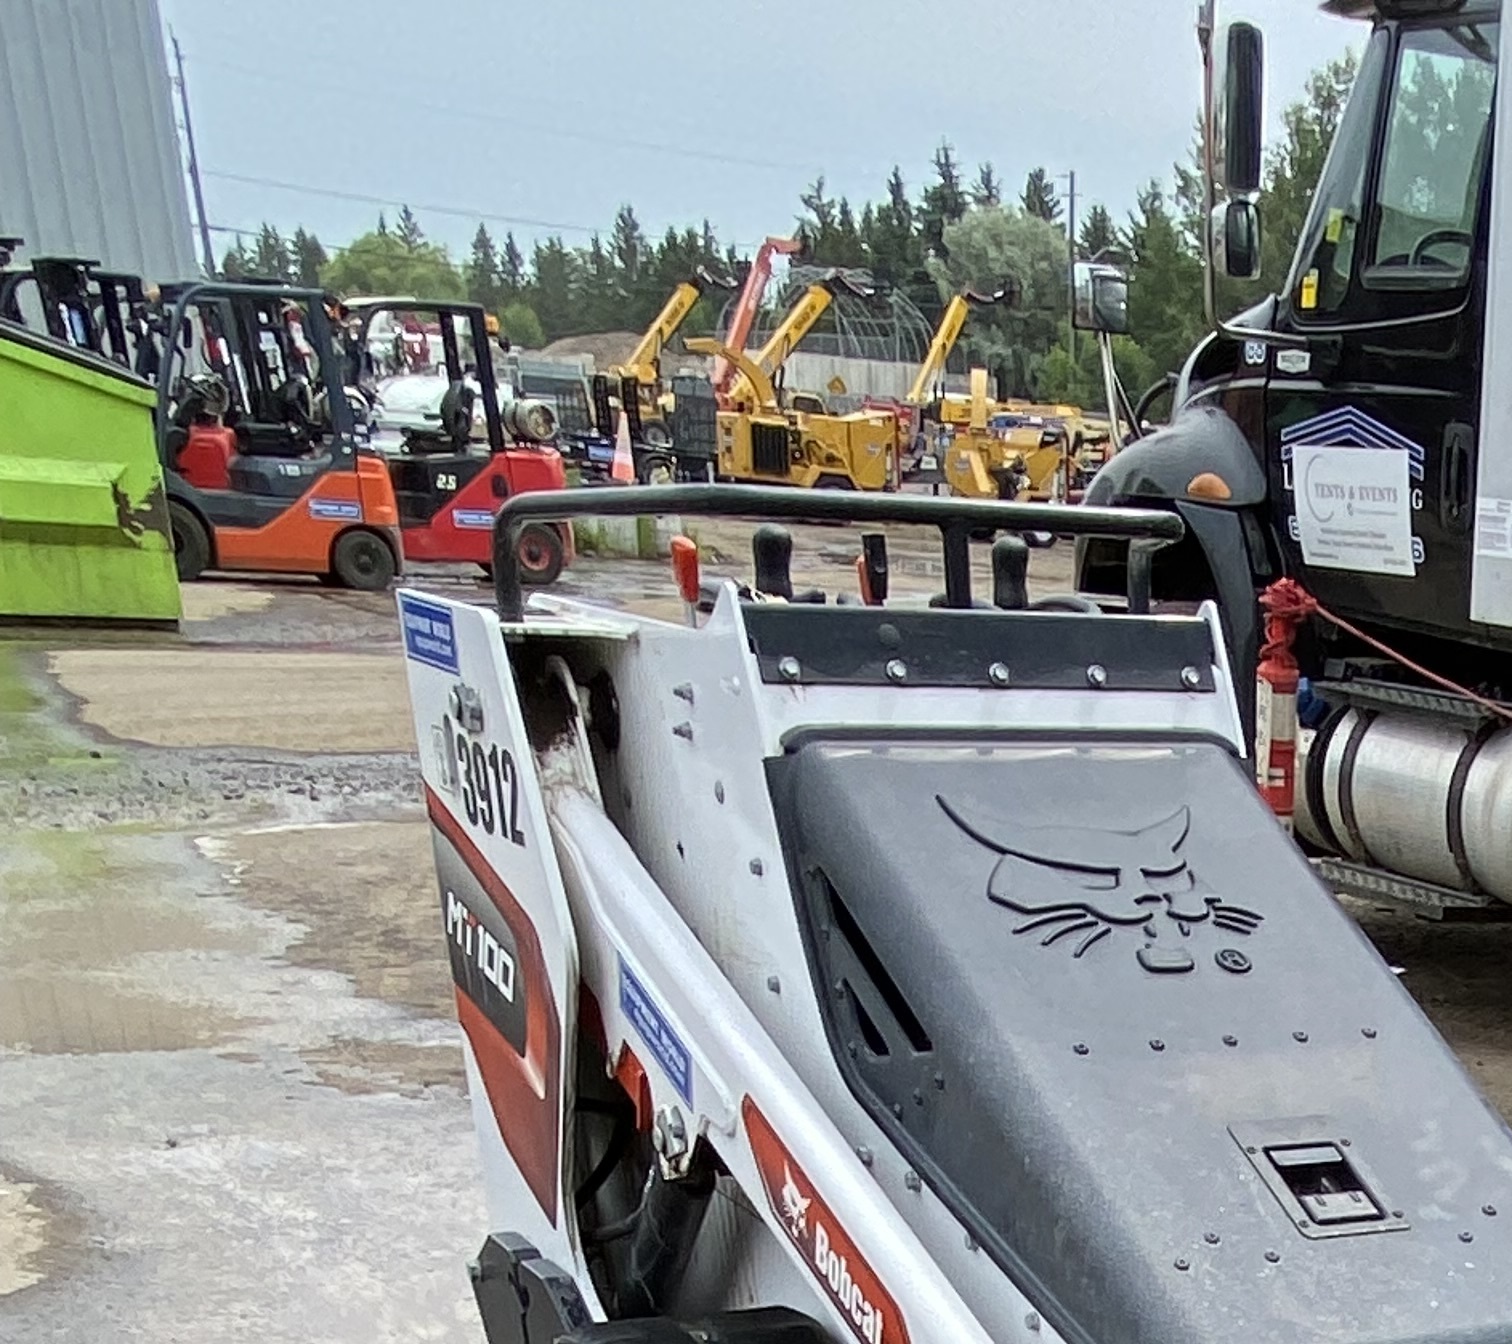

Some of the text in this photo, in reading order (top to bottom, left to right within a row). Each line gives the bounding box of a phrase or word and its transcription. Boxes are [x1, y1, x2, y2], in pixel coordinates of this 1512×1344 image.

[1314, 482, 1346, 501] TENTS
[1358, 485, 1398, 504] EVENTS
[456, 732, 527, 848] 3912
[446, 890, 516, 1003] MT100
